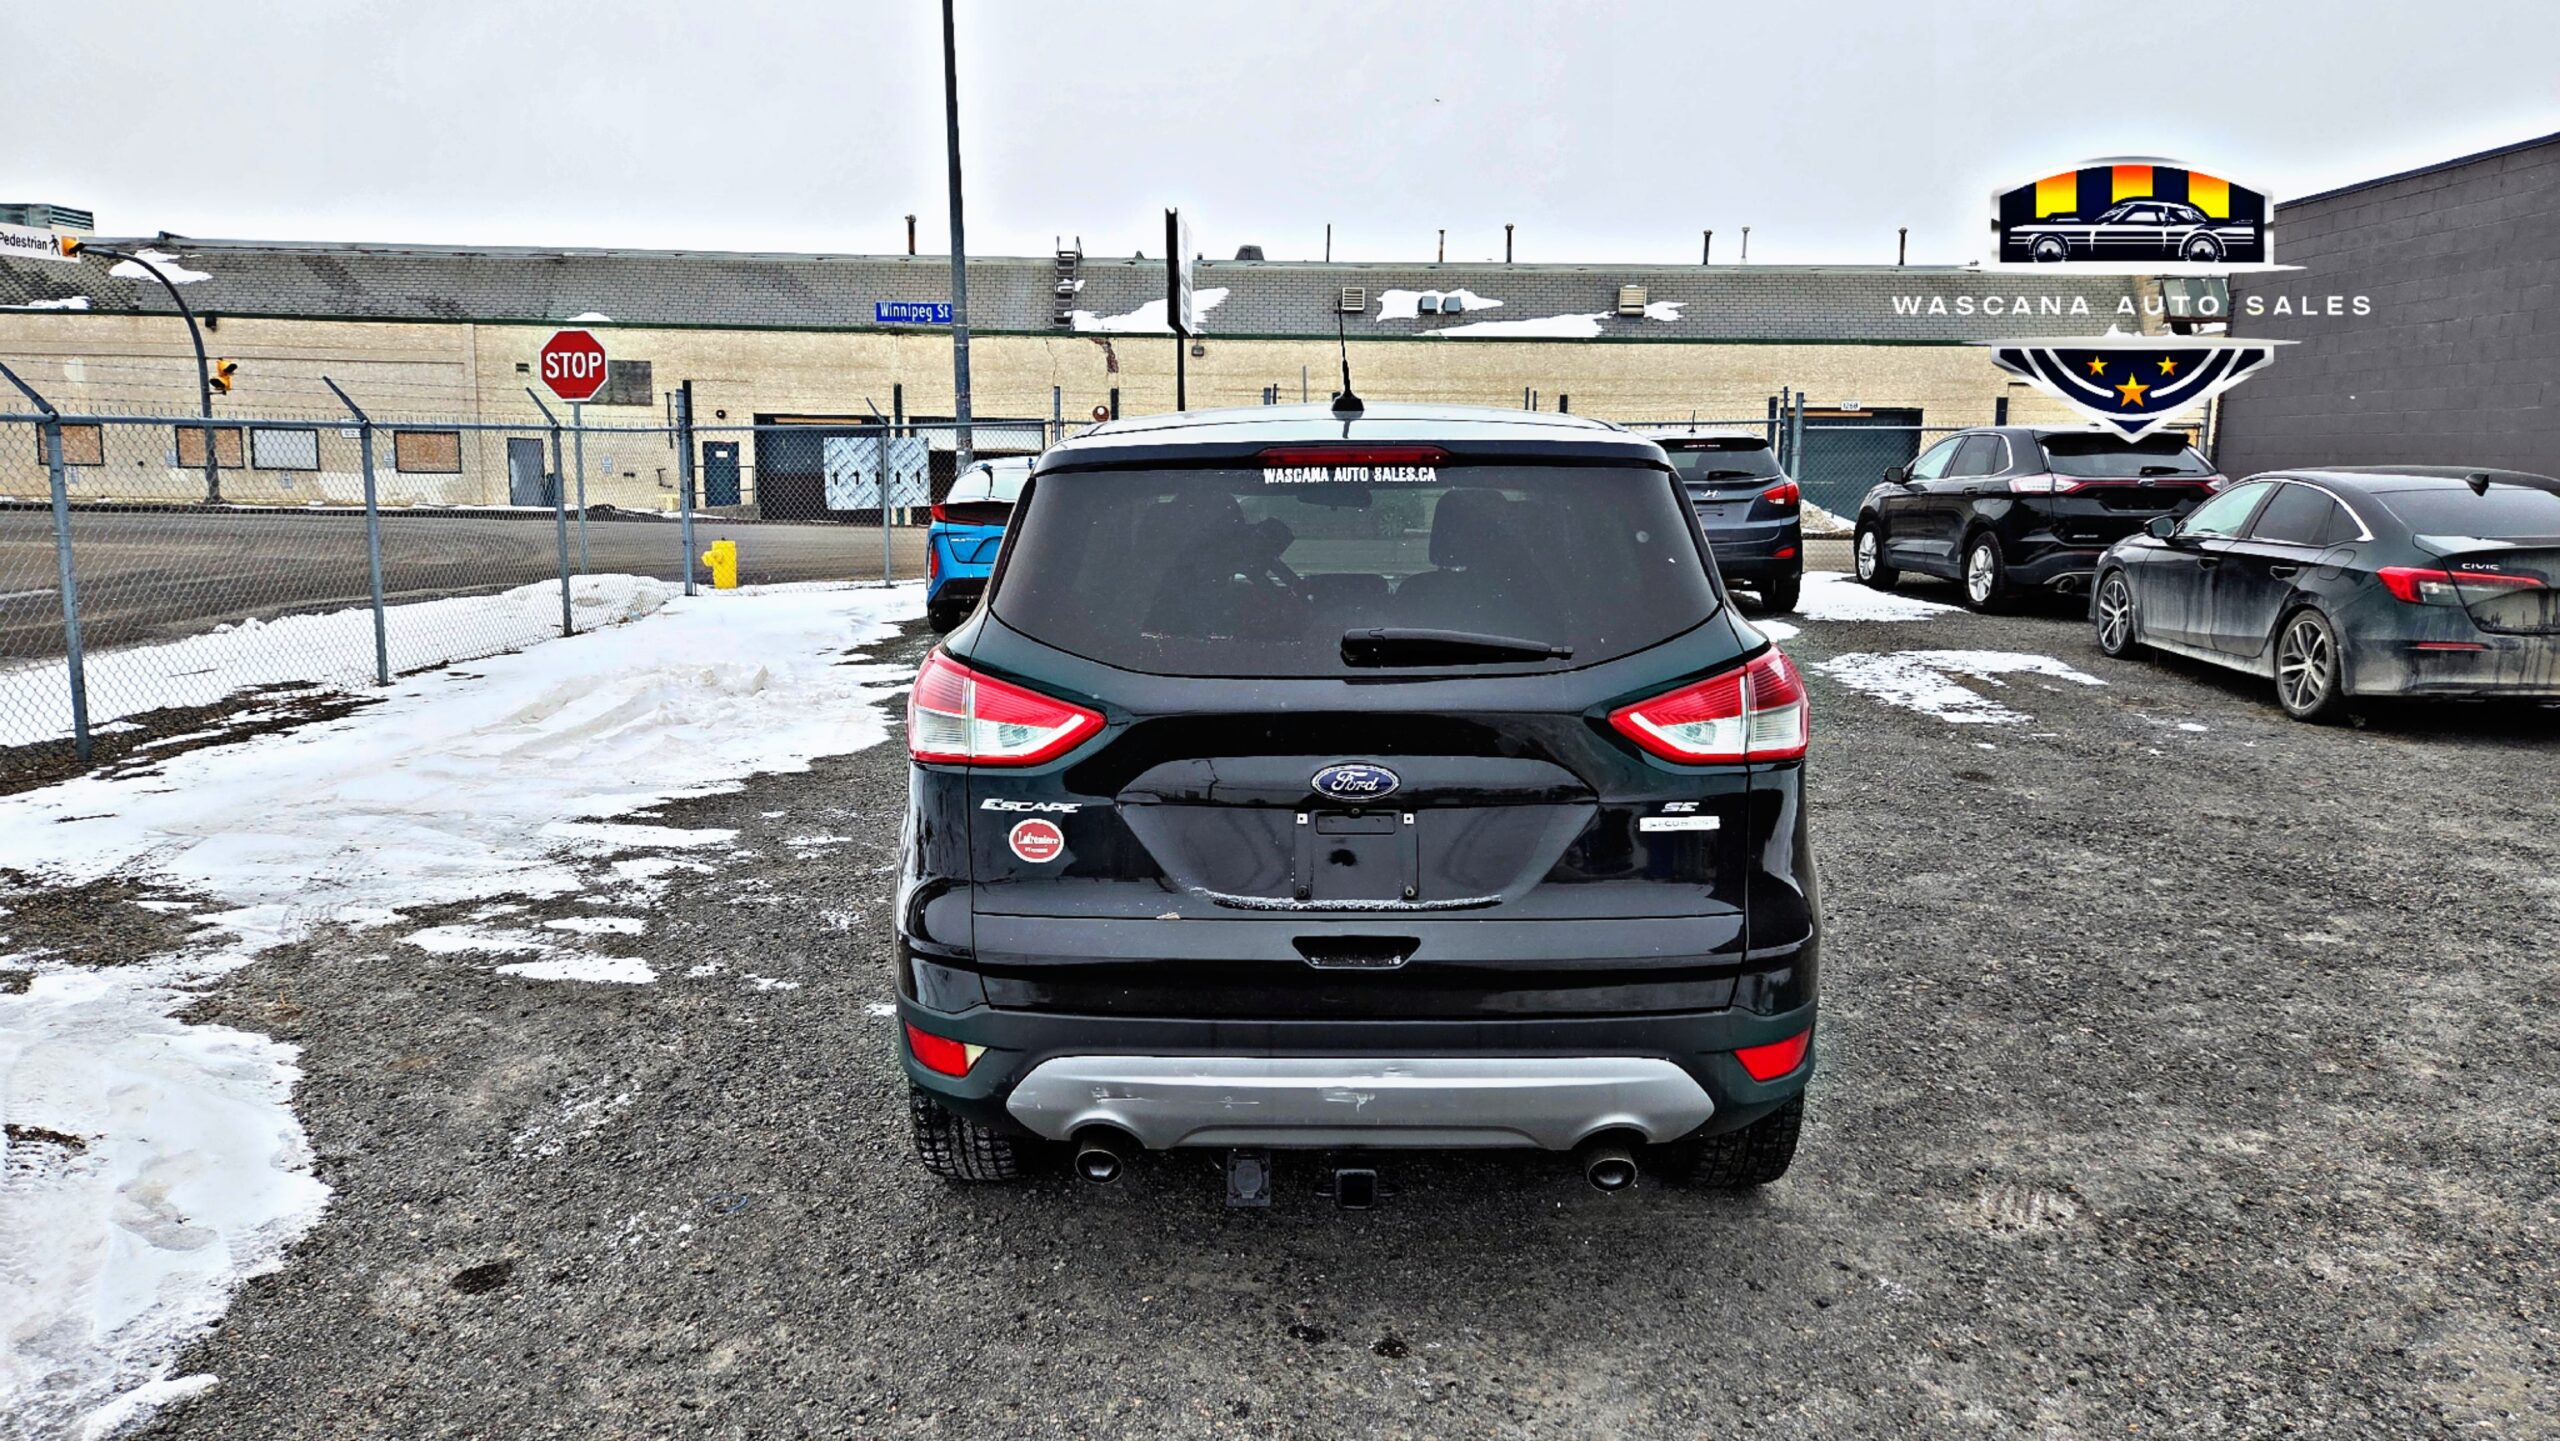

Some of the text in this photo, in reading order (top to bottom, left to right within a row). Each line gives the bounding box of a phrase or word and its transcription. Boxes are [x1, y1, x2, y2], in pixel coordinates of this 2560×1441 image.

[880, 302, 950, 322] Winnipeg St
[545, 351, 602, 379] STOP
[1263, 466, 1437, 484] WASCANA AUTO SALES.CA
[2461, 562, 2501, 571] CIVIC
[1331, 770, 1380, 791] Ford
[980, 798, 1083, 813] ESCAPE
[1661, 801, 1700, 813] SE
